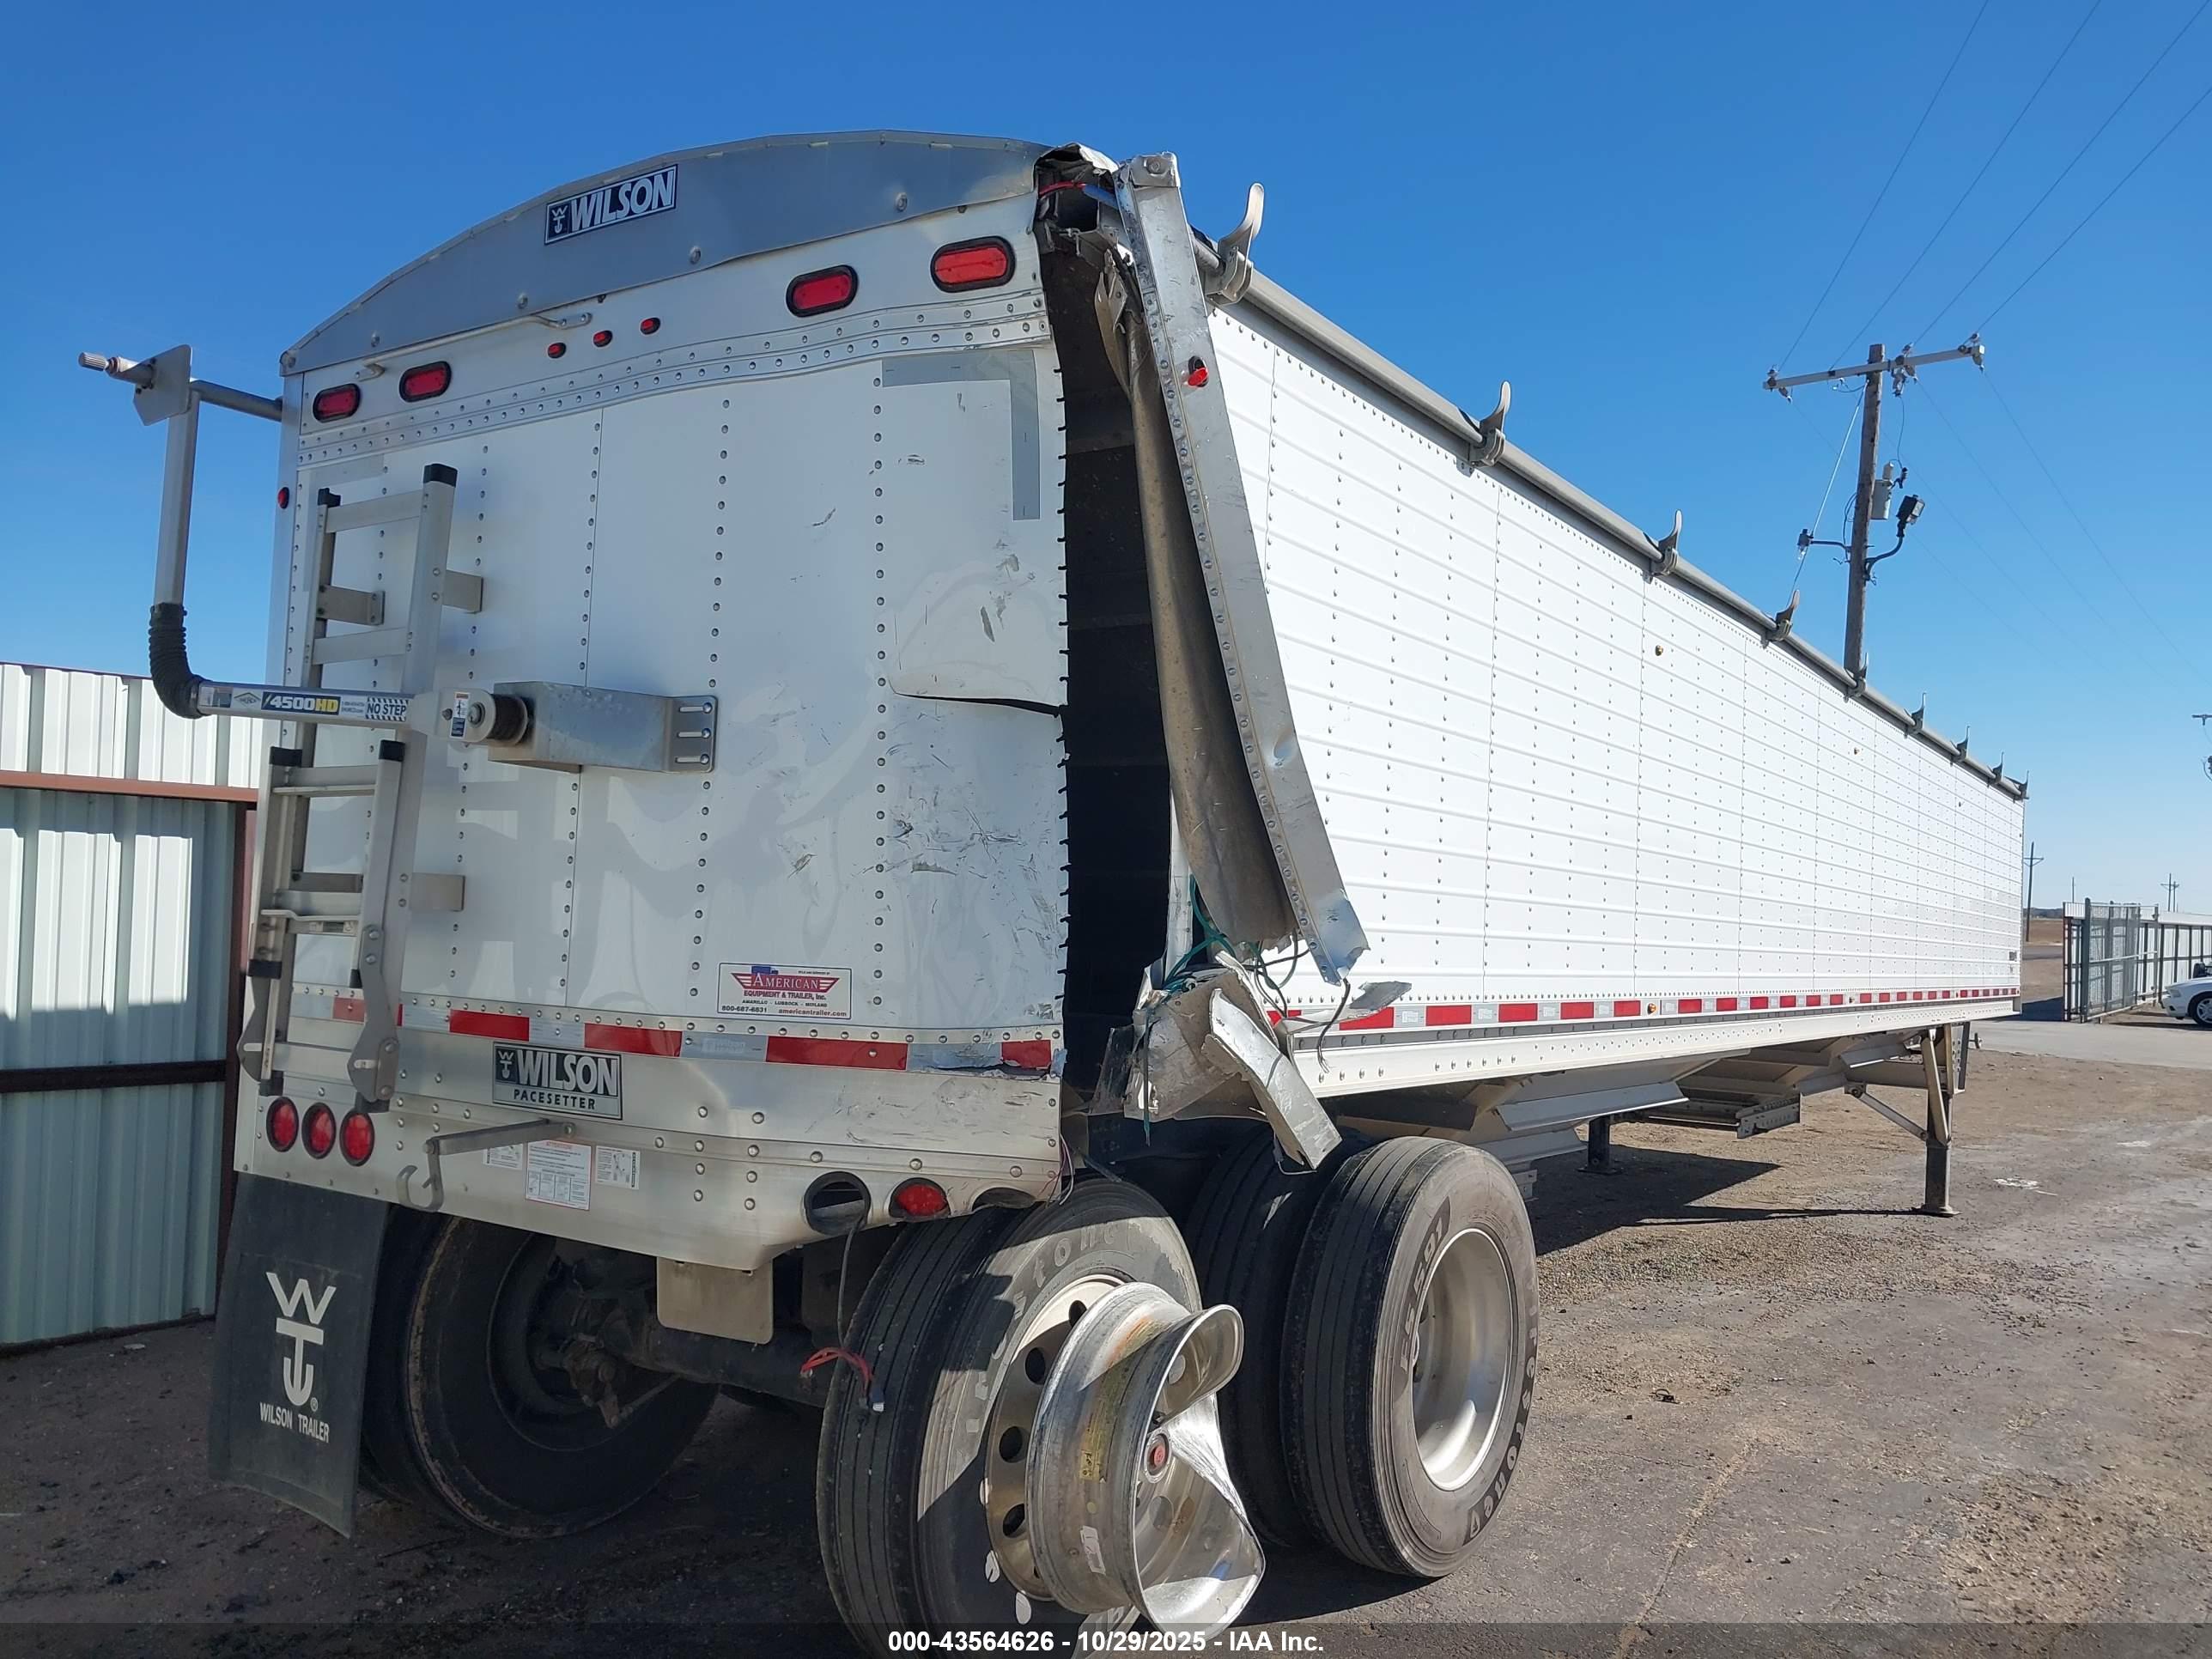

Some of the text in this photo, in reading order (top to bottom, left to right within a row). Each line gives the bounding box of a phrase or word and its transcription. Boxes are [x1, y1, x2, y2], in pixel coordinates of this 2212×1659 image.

[570, 170, 676, 232] WILSON
[270, 695, 338, 714] 4500HD
[367, 702, 381, 714] NO
[382, 703, 407, 716] STEP
[744, 990, 781, 999] EQUIPMENT
[778, 1008, 848, 1018] americantrailer.com
[517, 1049, 618, 1097] WILSON
[514, 1089, 595, 1110] PACESETTER
[260, 1402, 331, 1443] WILSON TRAILER
